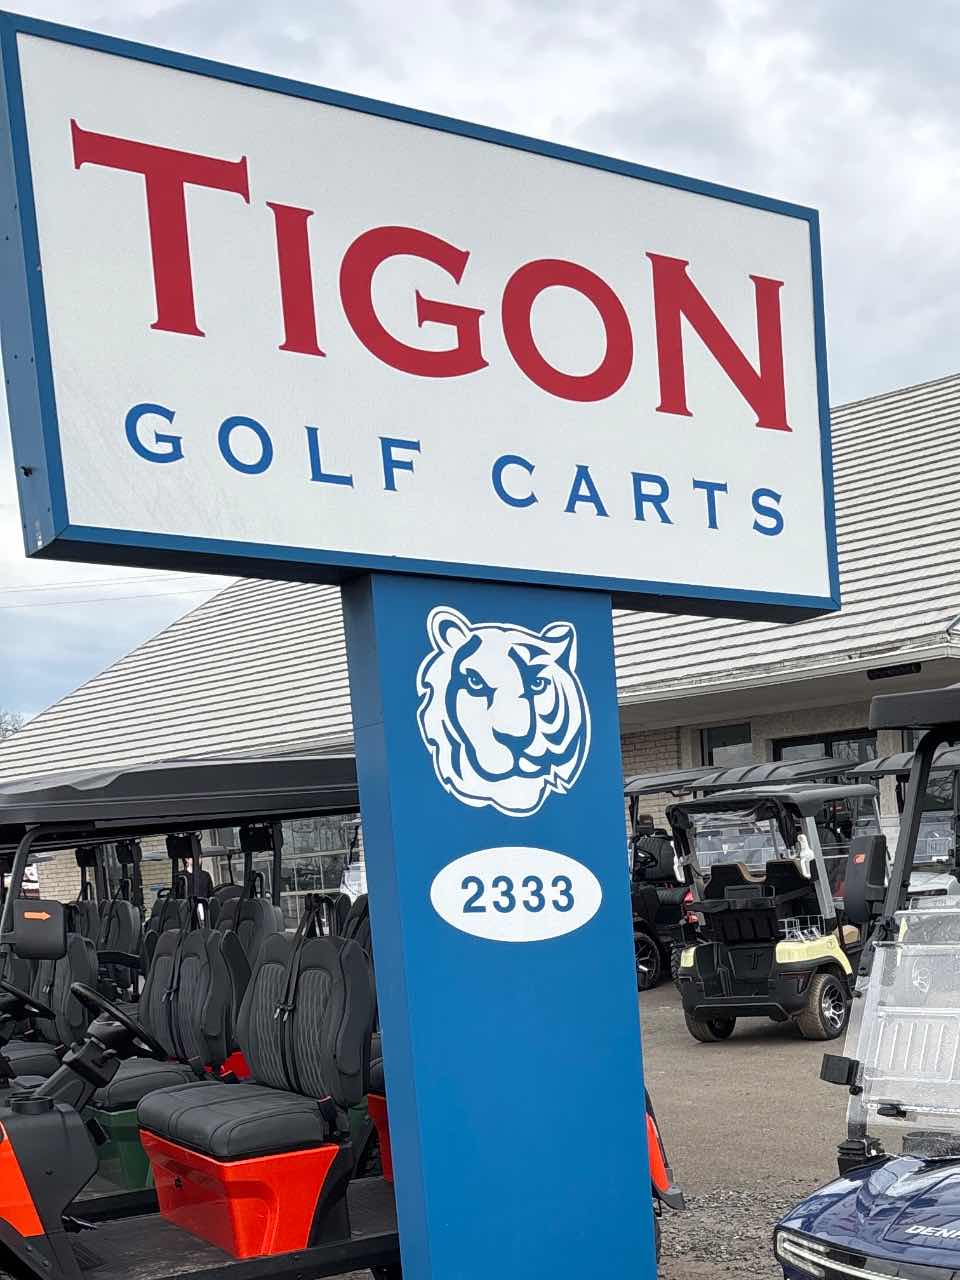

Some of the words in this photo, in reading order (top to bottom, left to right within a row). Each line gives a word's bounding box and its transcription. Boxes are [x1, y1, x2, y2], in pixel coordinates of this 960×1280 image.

[71, 118, 790, 432] TIGON
[125, 402, 421, 492] GOLF
[491, 453, 785, 537] CARTS
[461, 874, 575, 914] 2333
